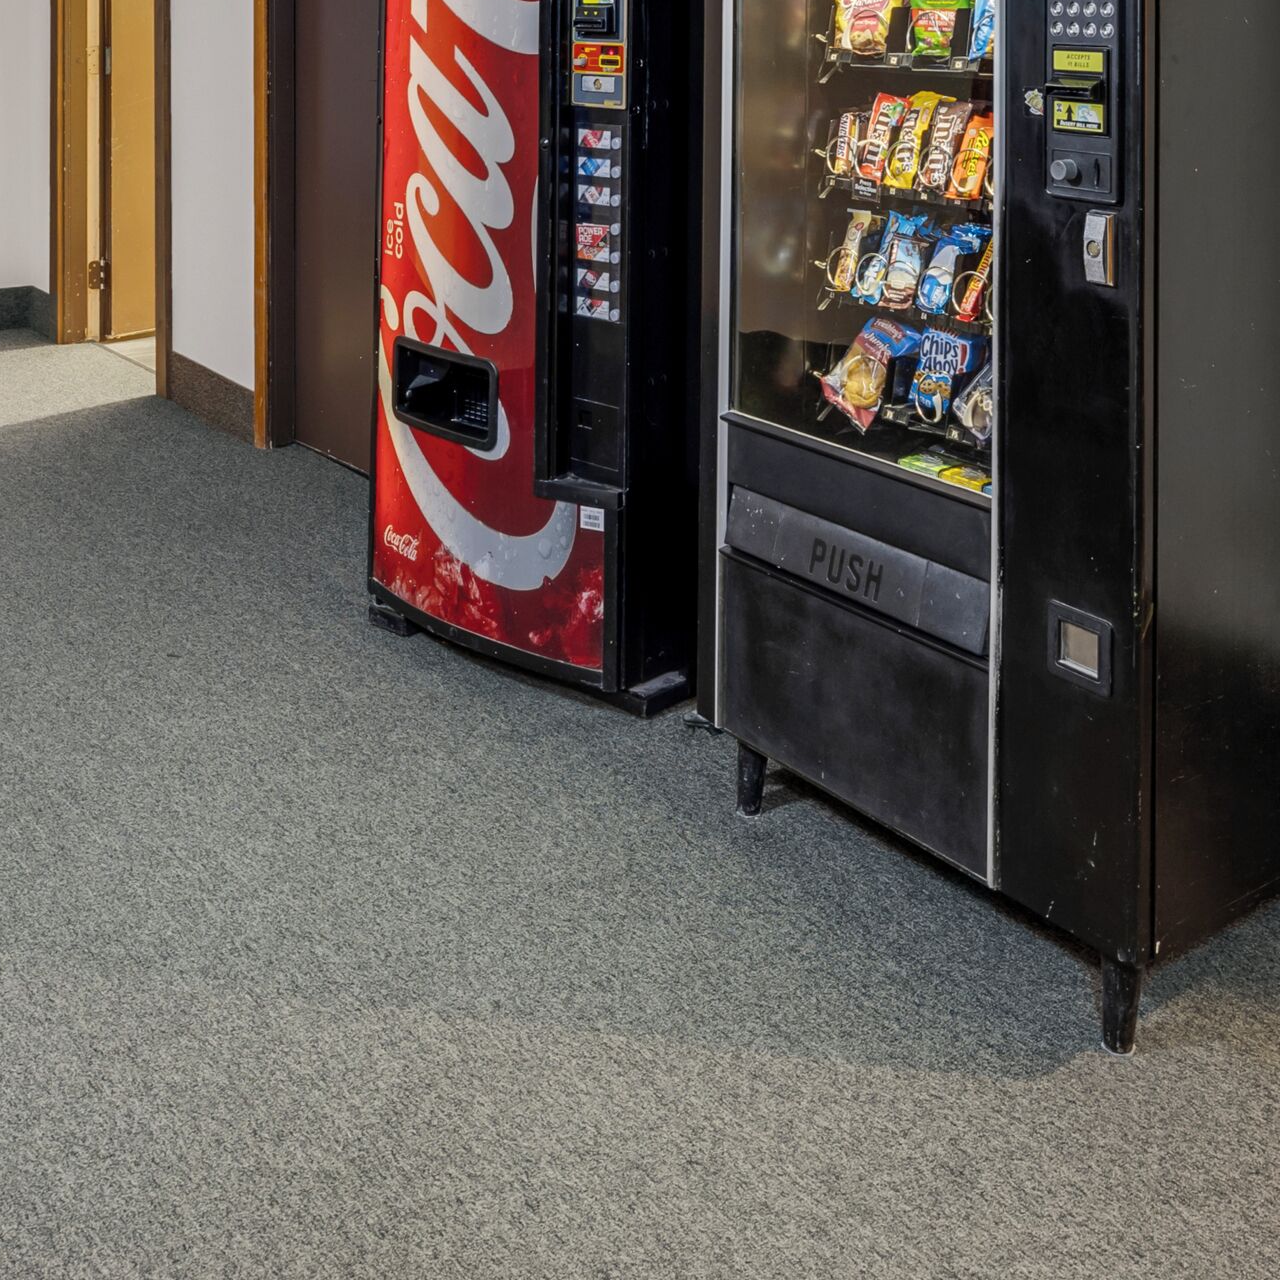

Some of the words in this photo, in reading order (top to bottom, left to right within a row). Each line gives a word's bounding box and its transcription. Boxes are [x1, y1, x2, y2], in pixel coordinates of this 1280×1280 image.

[1066, 53, 1091, 61] ACCEPTS
[837, 114, 850, 158] SNICKERS
[393, 201, 404, 260] cold
[578, 226, 603, 235] POWER
[922, 334, 959, 358] Chips
[384, 524, 420, 561] Coca-Cola
[808, 536, 884, 603] PUSH
